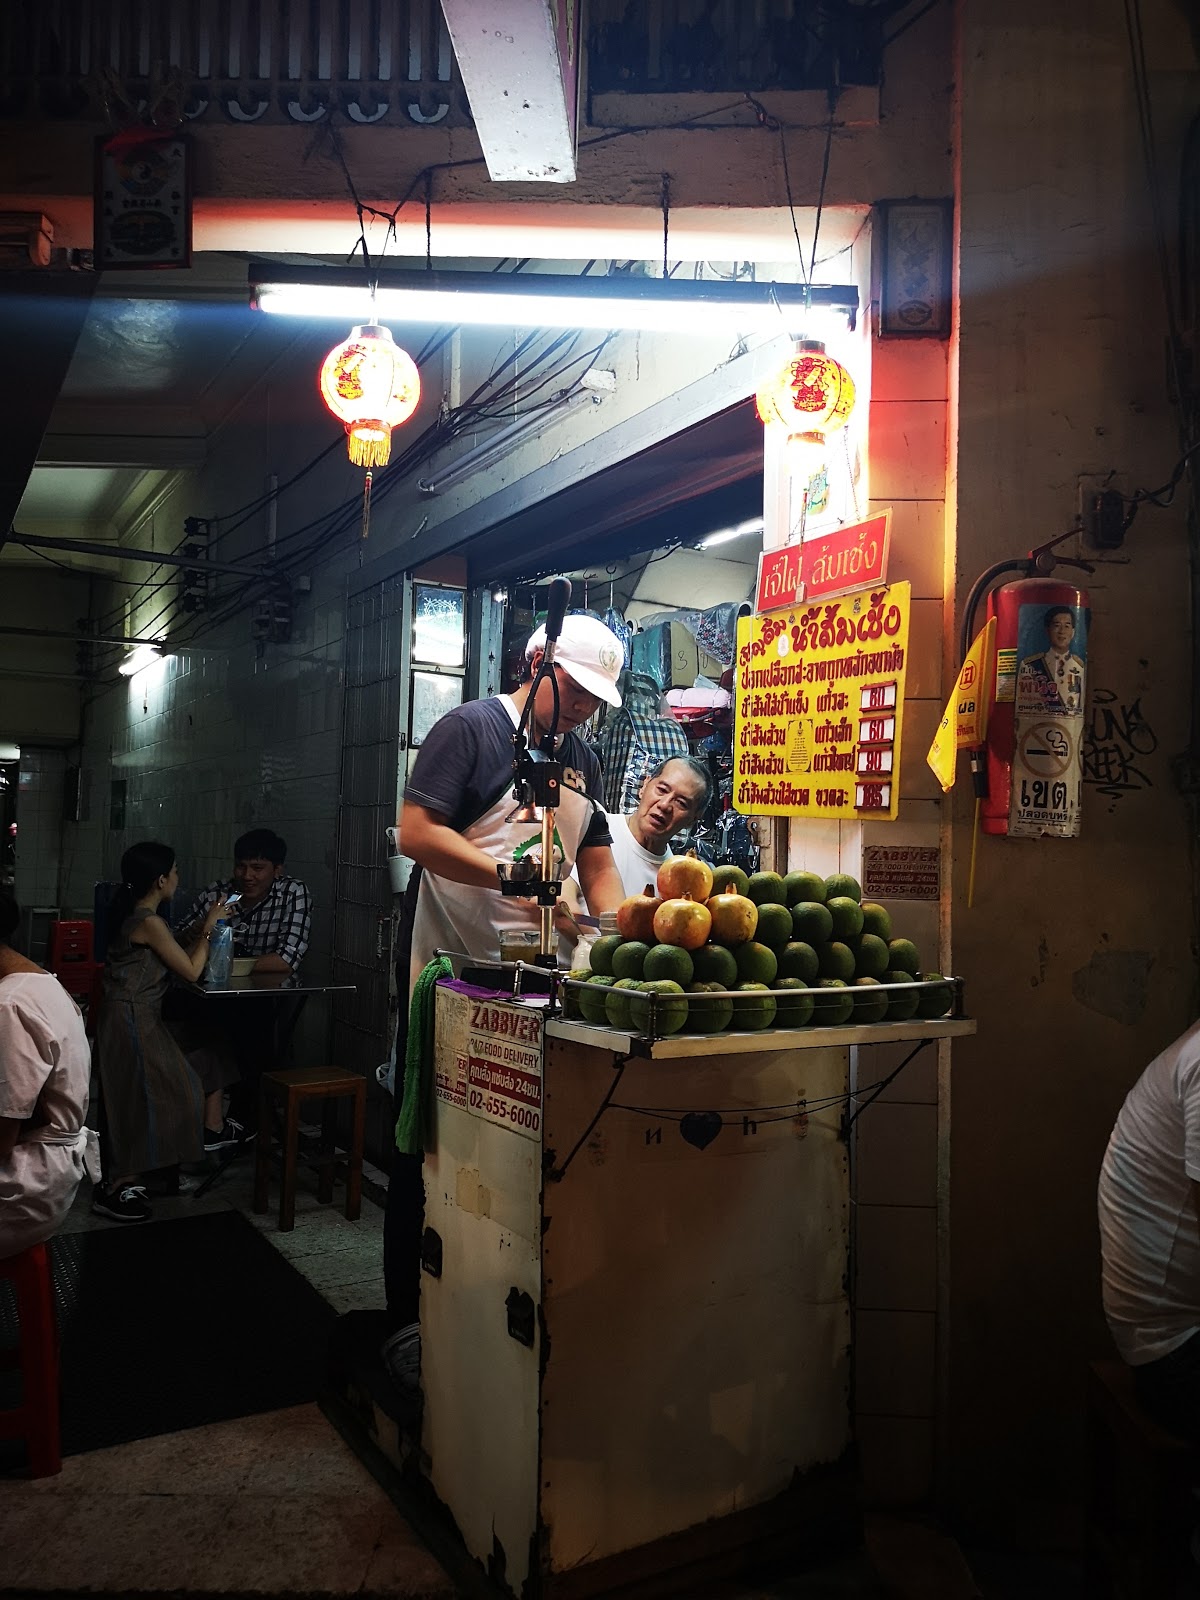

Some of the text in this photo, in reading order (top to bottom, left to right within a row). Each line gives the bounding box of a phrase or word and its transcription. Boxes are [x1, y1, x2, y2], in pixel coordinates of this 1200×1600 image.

[811, 532, 878, 586] ส้มเช้ง
[868, 719, 884, 741] 60
[865, 750, 882, 772] 90
[816, 788, 848, 807] ขวดละ
[1021, 780, 1067, 810] เขต
[867, 885, 938, 895] 02-655-6000
[470, 1005, 540, 1044] ZABBVER
[503, 1047, 540, 1069] DELIVERY
[469, 1090, 540, 1133] 02-655-6000
